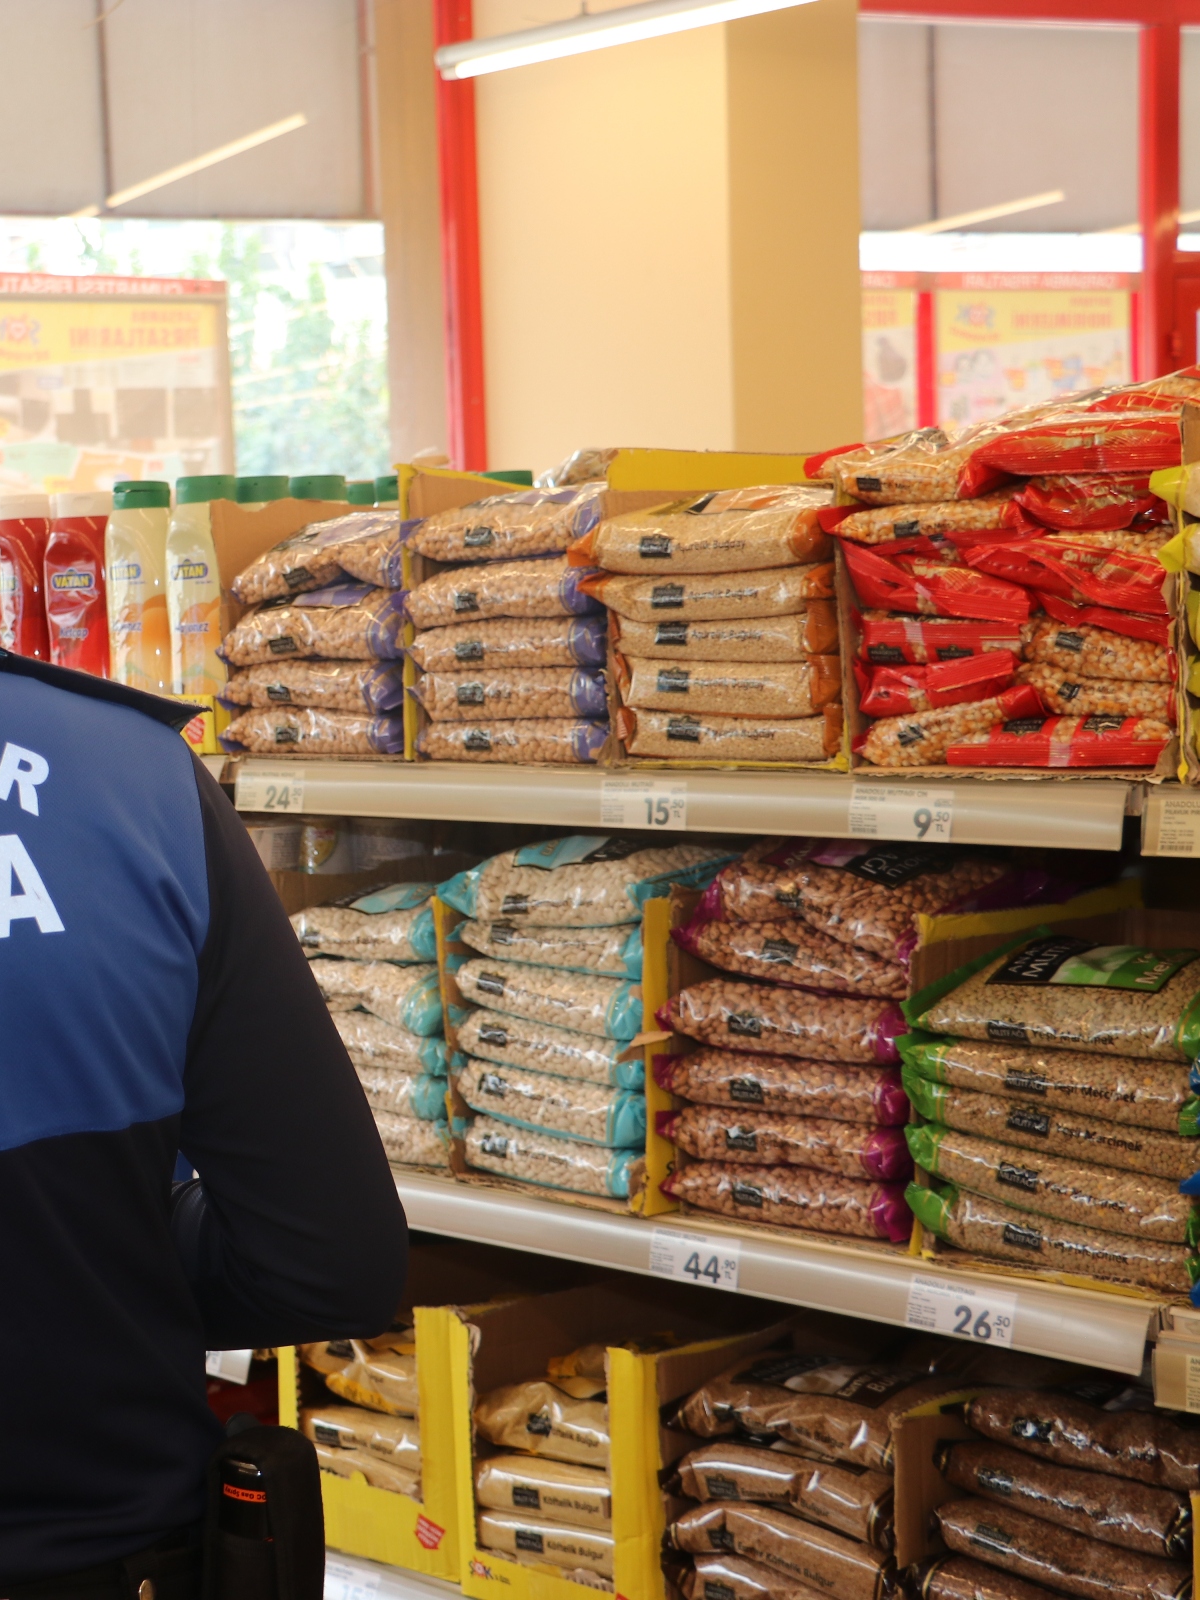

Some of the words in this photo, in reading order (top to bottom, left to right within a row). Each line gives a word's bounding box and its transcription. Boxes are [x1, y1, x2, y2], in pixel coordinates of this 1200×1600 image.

[56, 575, 90, 588] VATAN
[264, 785, 291, 809] 24
[644, 797, 669, 826] 15
[913, 808, 932, 839] 9
[683, 1251, 720, 1283] 44
[953, 1305, 992, 1339] 26
[575, 1499, 600, 1513] Bulgur
[580, 1545, 604, 1560] Bulgur
[804, 1567, 835, 1587] Bulgur
